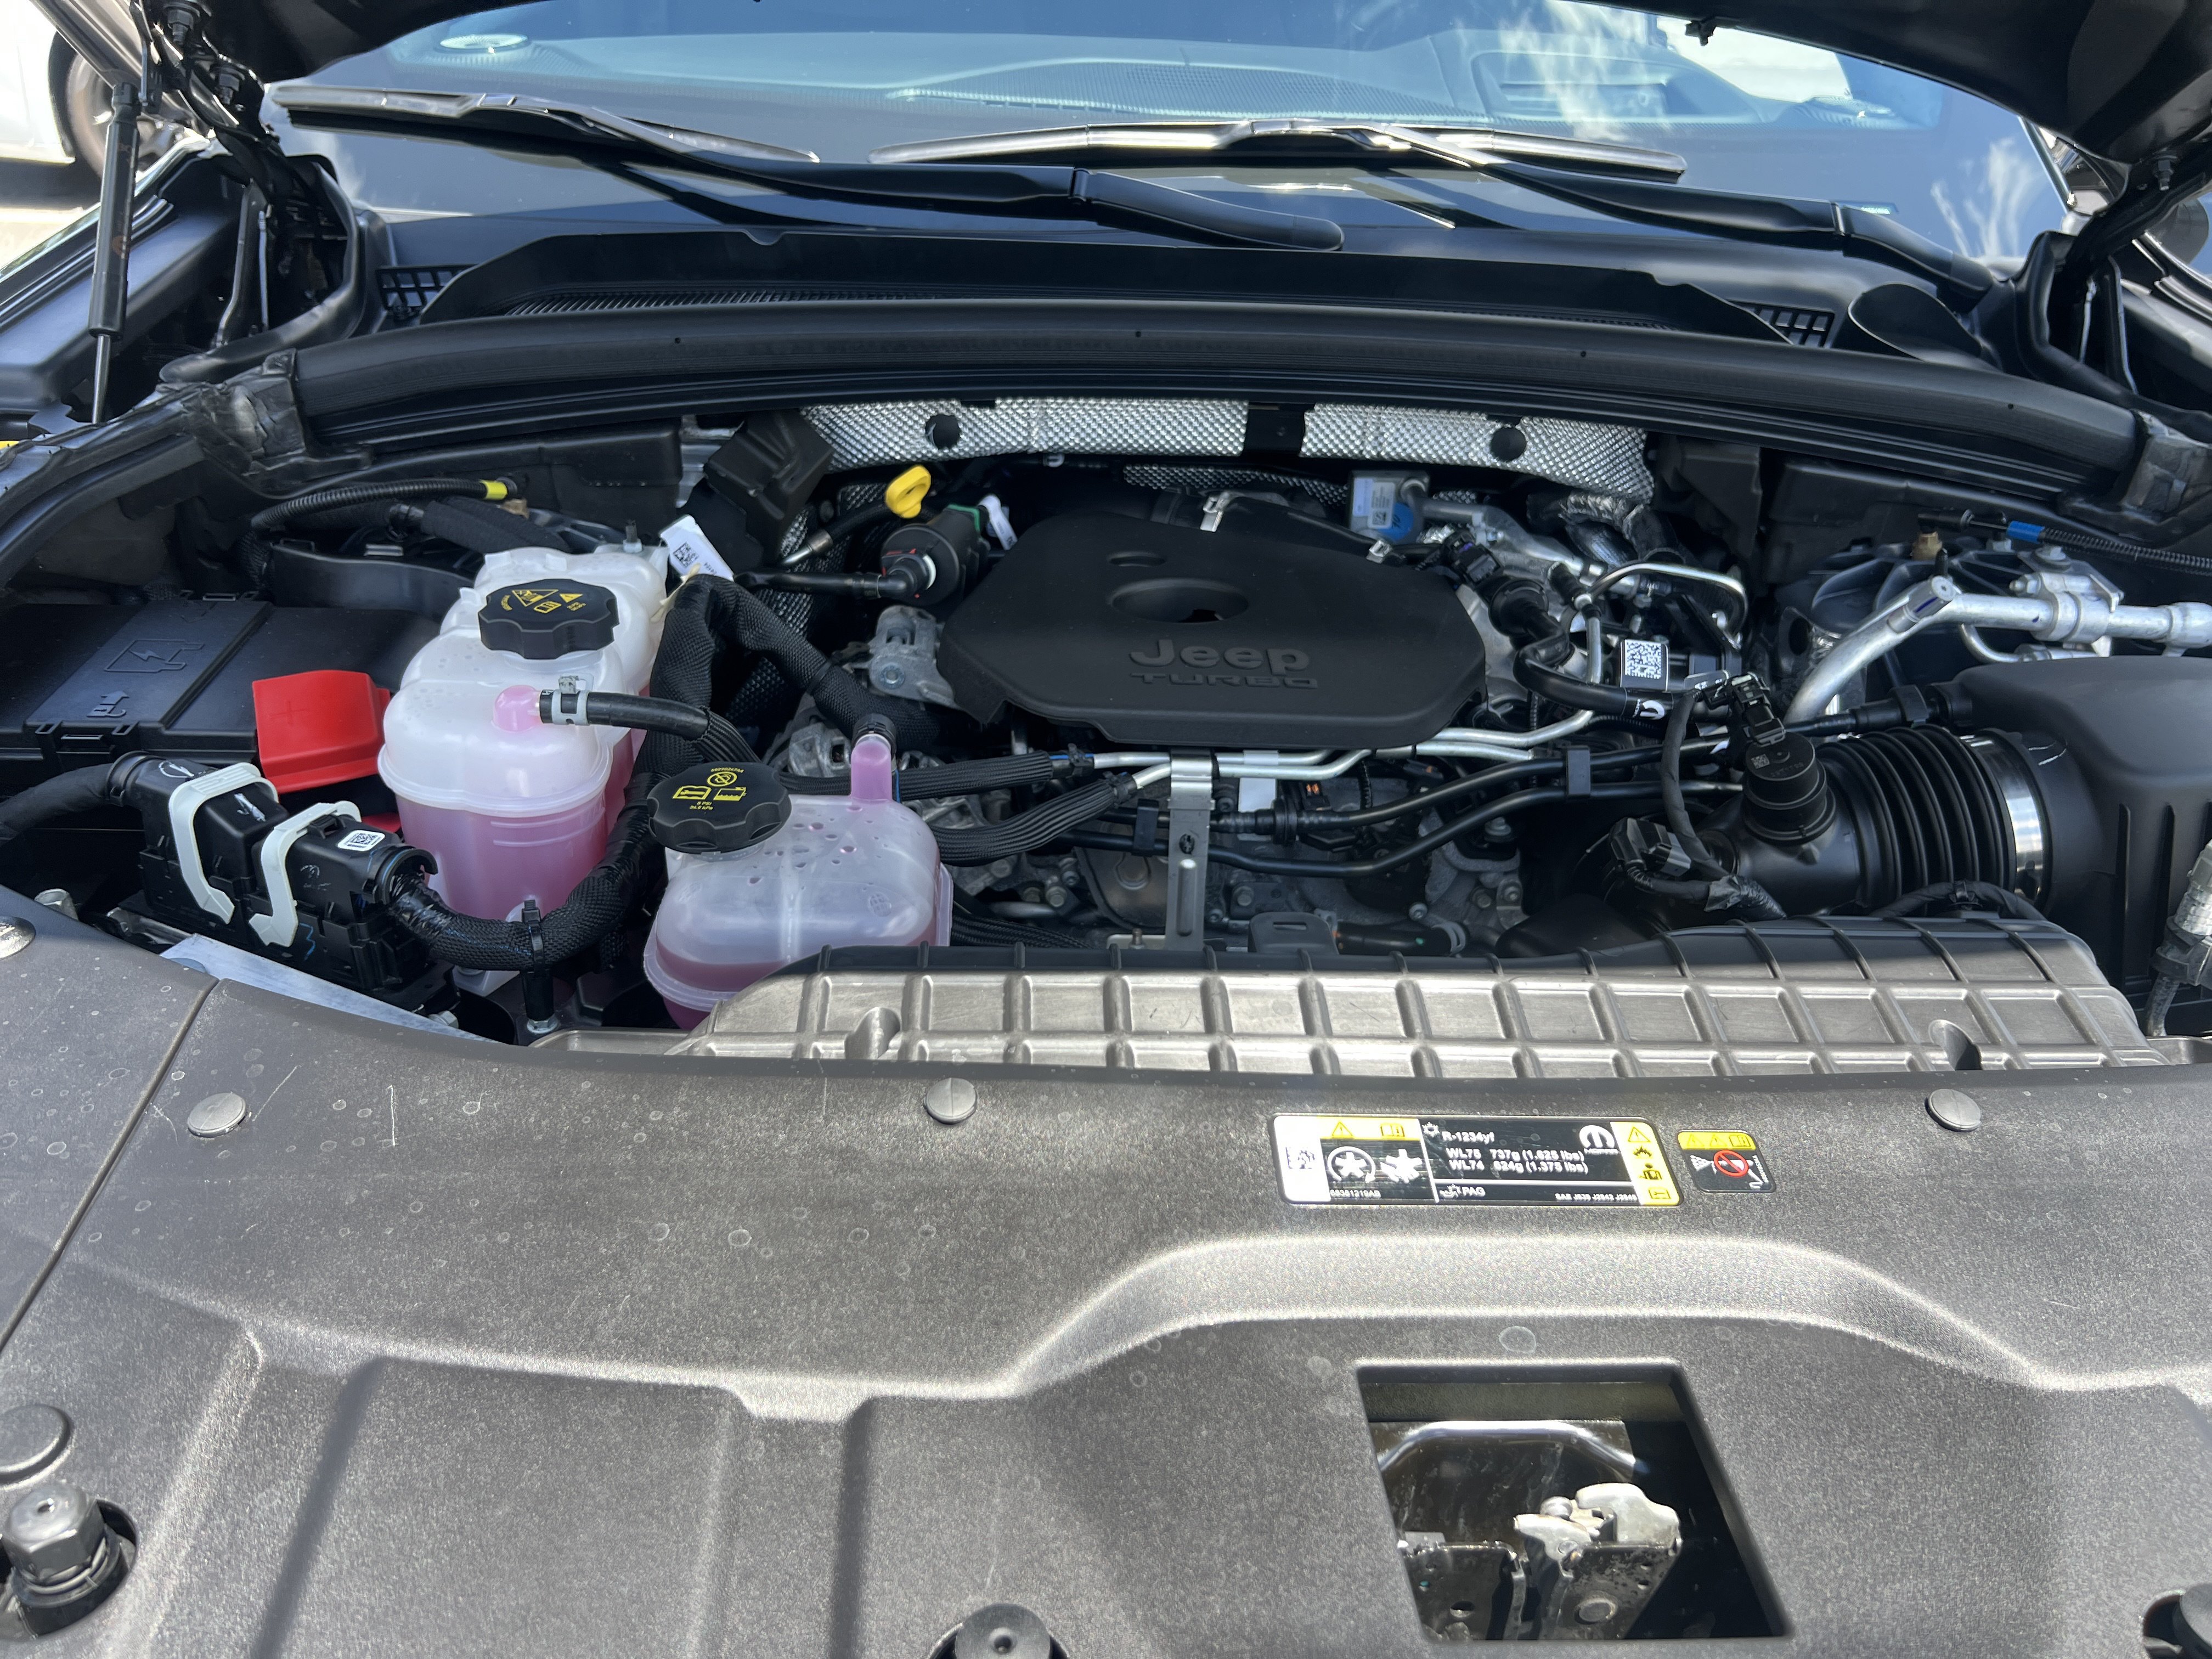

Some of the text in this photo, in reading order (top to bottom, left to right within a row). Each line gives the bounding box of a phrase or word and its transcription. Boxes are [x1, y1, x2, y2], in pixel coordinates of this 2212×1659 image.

[1129, 640, 1310, 676] Jeep
[1130, 673, 1317, 689] TURBO
[1442, 1131, 1495, 1145] R-1234yf
[1445, 1148, 1482, 1159] WL75
[1560, 1150, 1585, 1162] lbs)
[1448, 1159, 1485, 1171] WL74
[1564, 1161, 1589, 1175] lbs)
[1462, 1187, 1486, 1197] PAG
